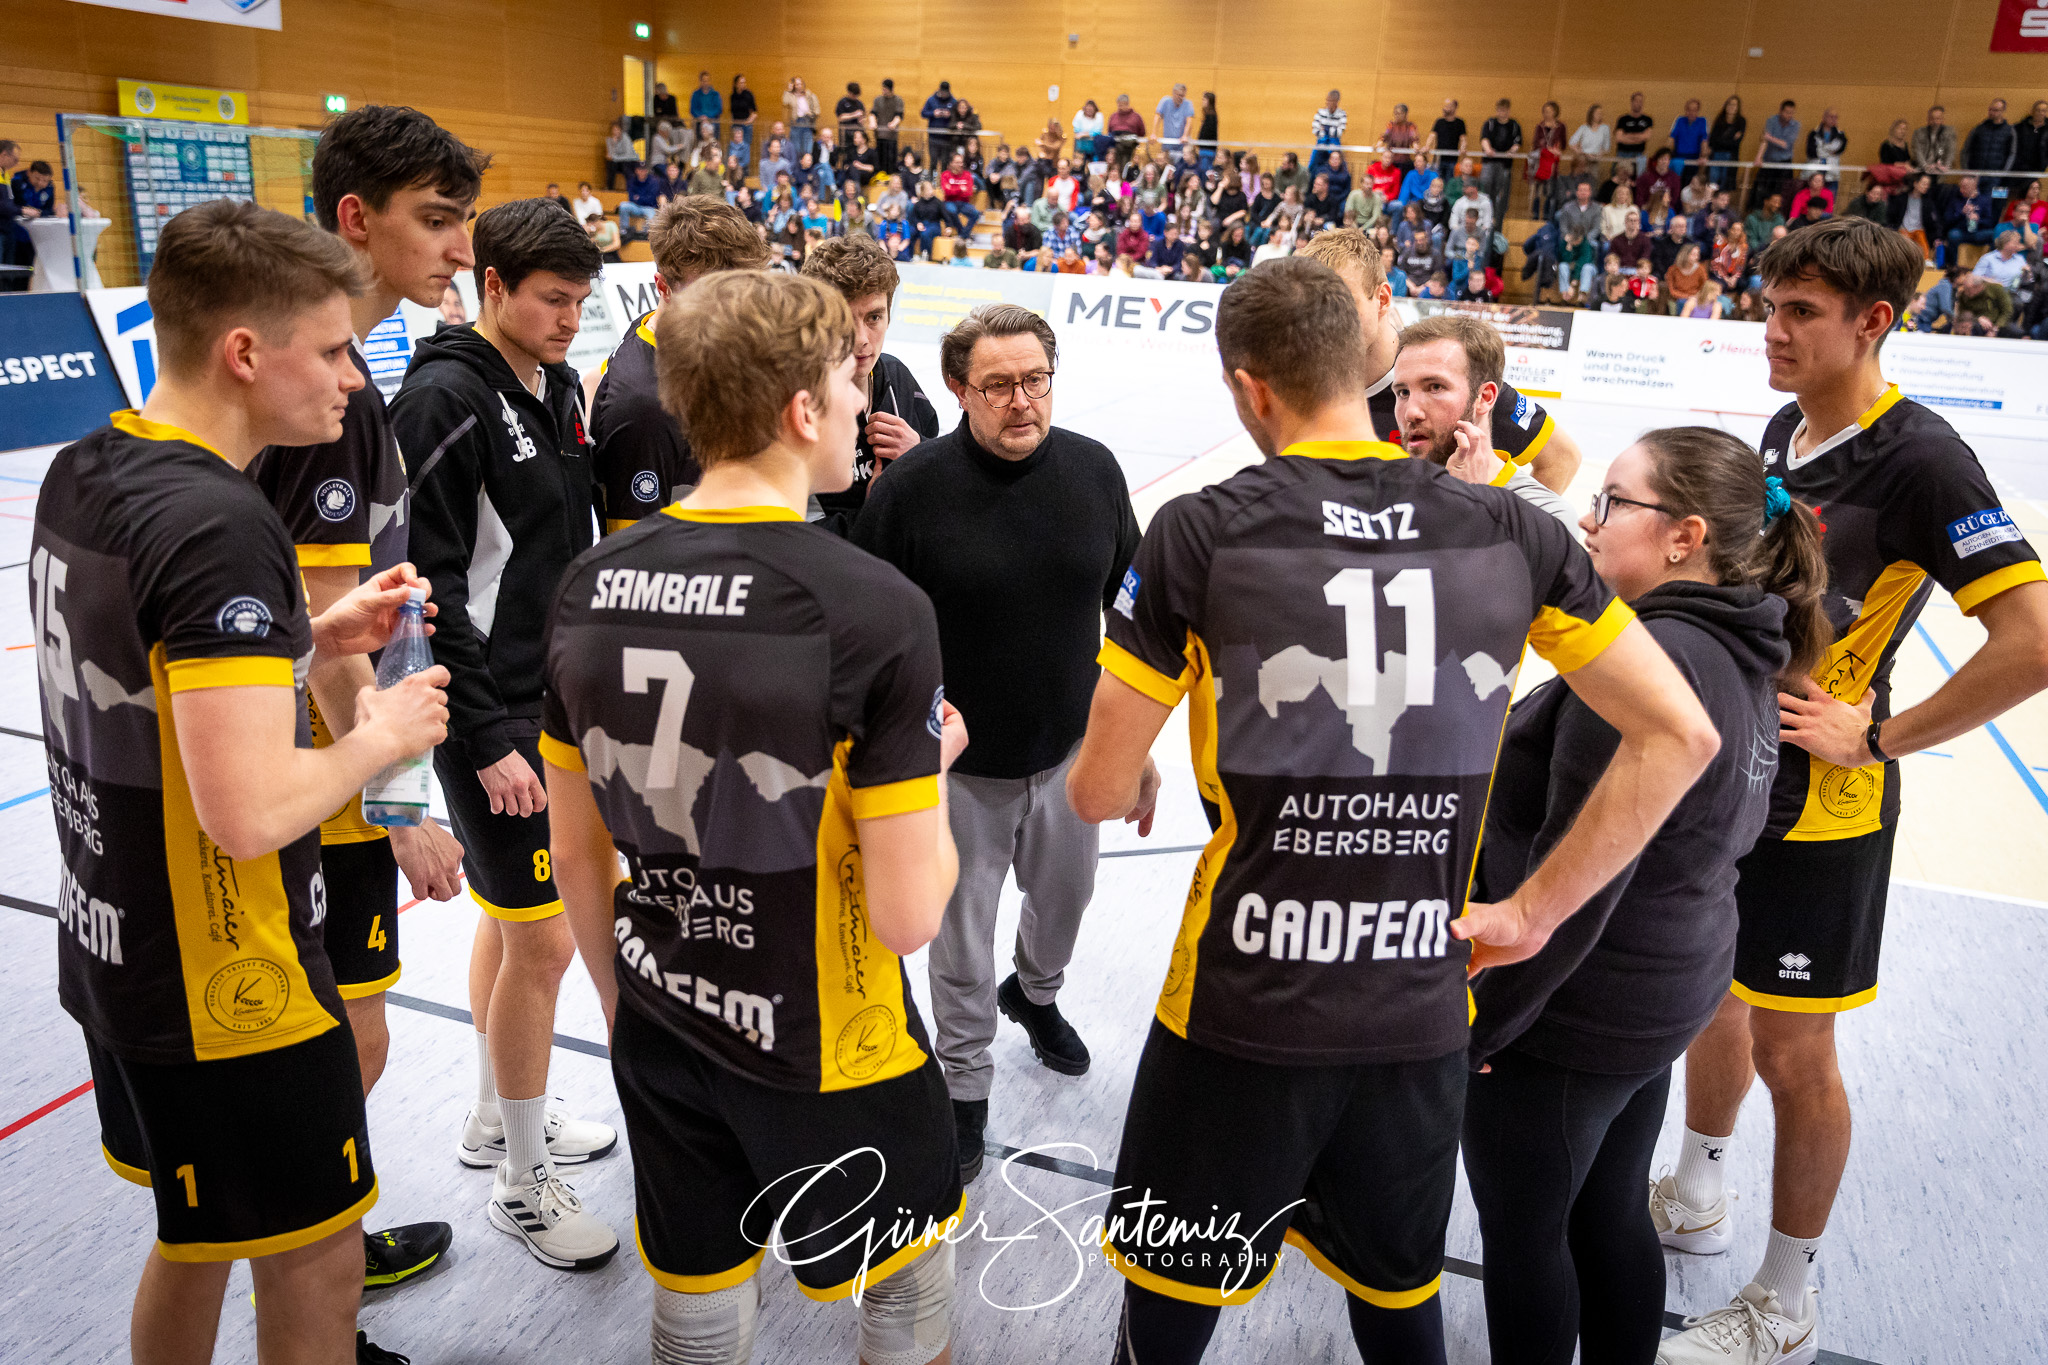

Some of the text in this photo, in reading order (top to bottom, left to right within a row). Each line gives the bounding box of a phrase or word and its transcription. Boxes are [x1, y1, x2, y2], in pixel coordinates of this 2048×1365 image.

[1613, 364, 1660, 377] Design
[1626, 351, 1666, 364] Druck
[320, 483, 350, 498] VOLLEYBALL
[1322, 499, 1420, 540] SEITZ
[1954, 510, 2011, 537] RÜGER
[226, 603, 268, 620] VOLLEYBALL
[591, 568, 754, 617] SAMBALE
[32, 545, 80, 700] 15
[1322, 567, 1437, 706] 11
[622, 646, 696, 789] 7
[1278, 792, 1460, 821] AUTOHAUS
[1272, 827, 1451, 857] EBERSBERG
[532, 849, 551, 882] 8
[635, 857, 754, 915] UTOAUS
[59, 853, 124, 965] DFEM
[1232, 892, 1450, 964] CADFEM
[367, 914, 387, 952] 4
[1778, 969, 1811, 981] errea
[343, 1136, 359, 1183] 1
[176, 1164, 198, 1207] 1
